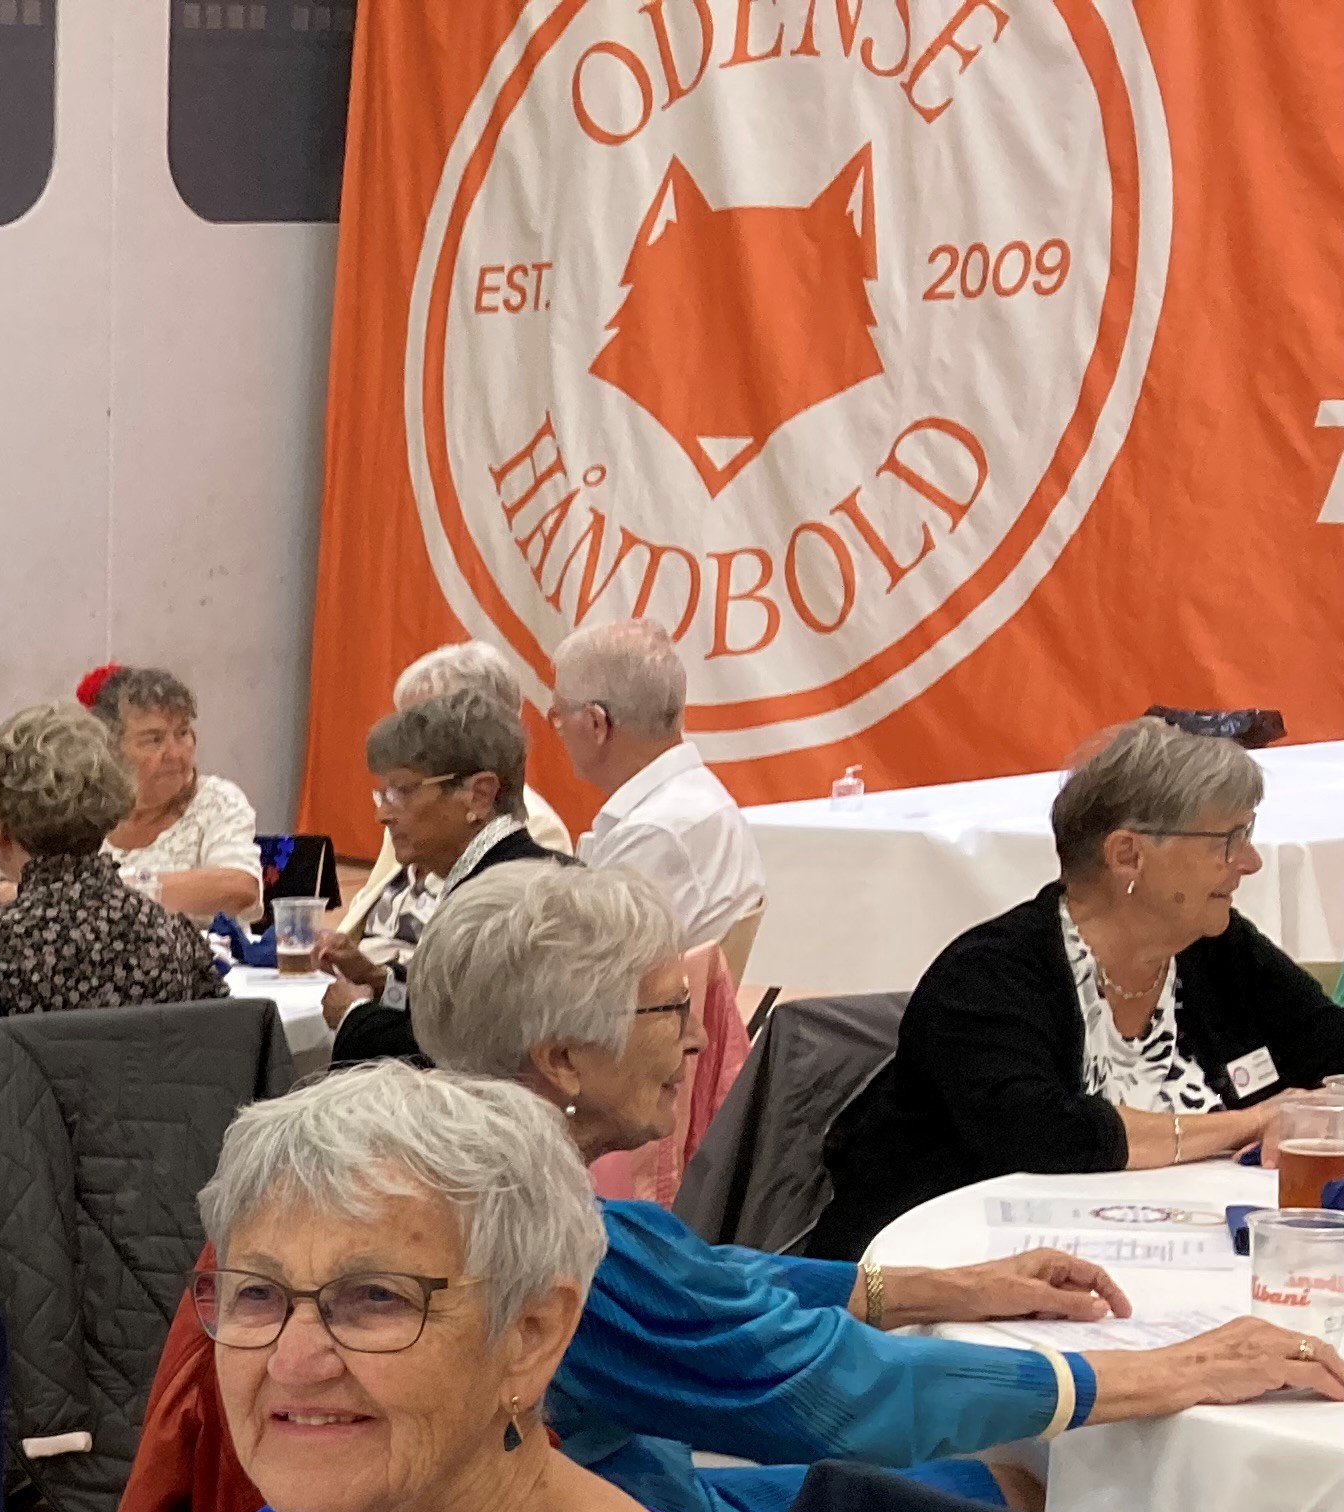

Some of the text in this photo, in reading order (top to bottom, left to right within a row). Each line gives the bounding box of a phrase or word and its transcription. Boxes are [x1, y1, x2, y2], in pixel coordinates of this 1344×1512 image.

[571, 0, 1011, 147] ODENSE
[474, 260, 553, 314] EST.
[922, 237, 1071, 301] 2009
[487, 411, 989, 661] HÅNDBOLD
